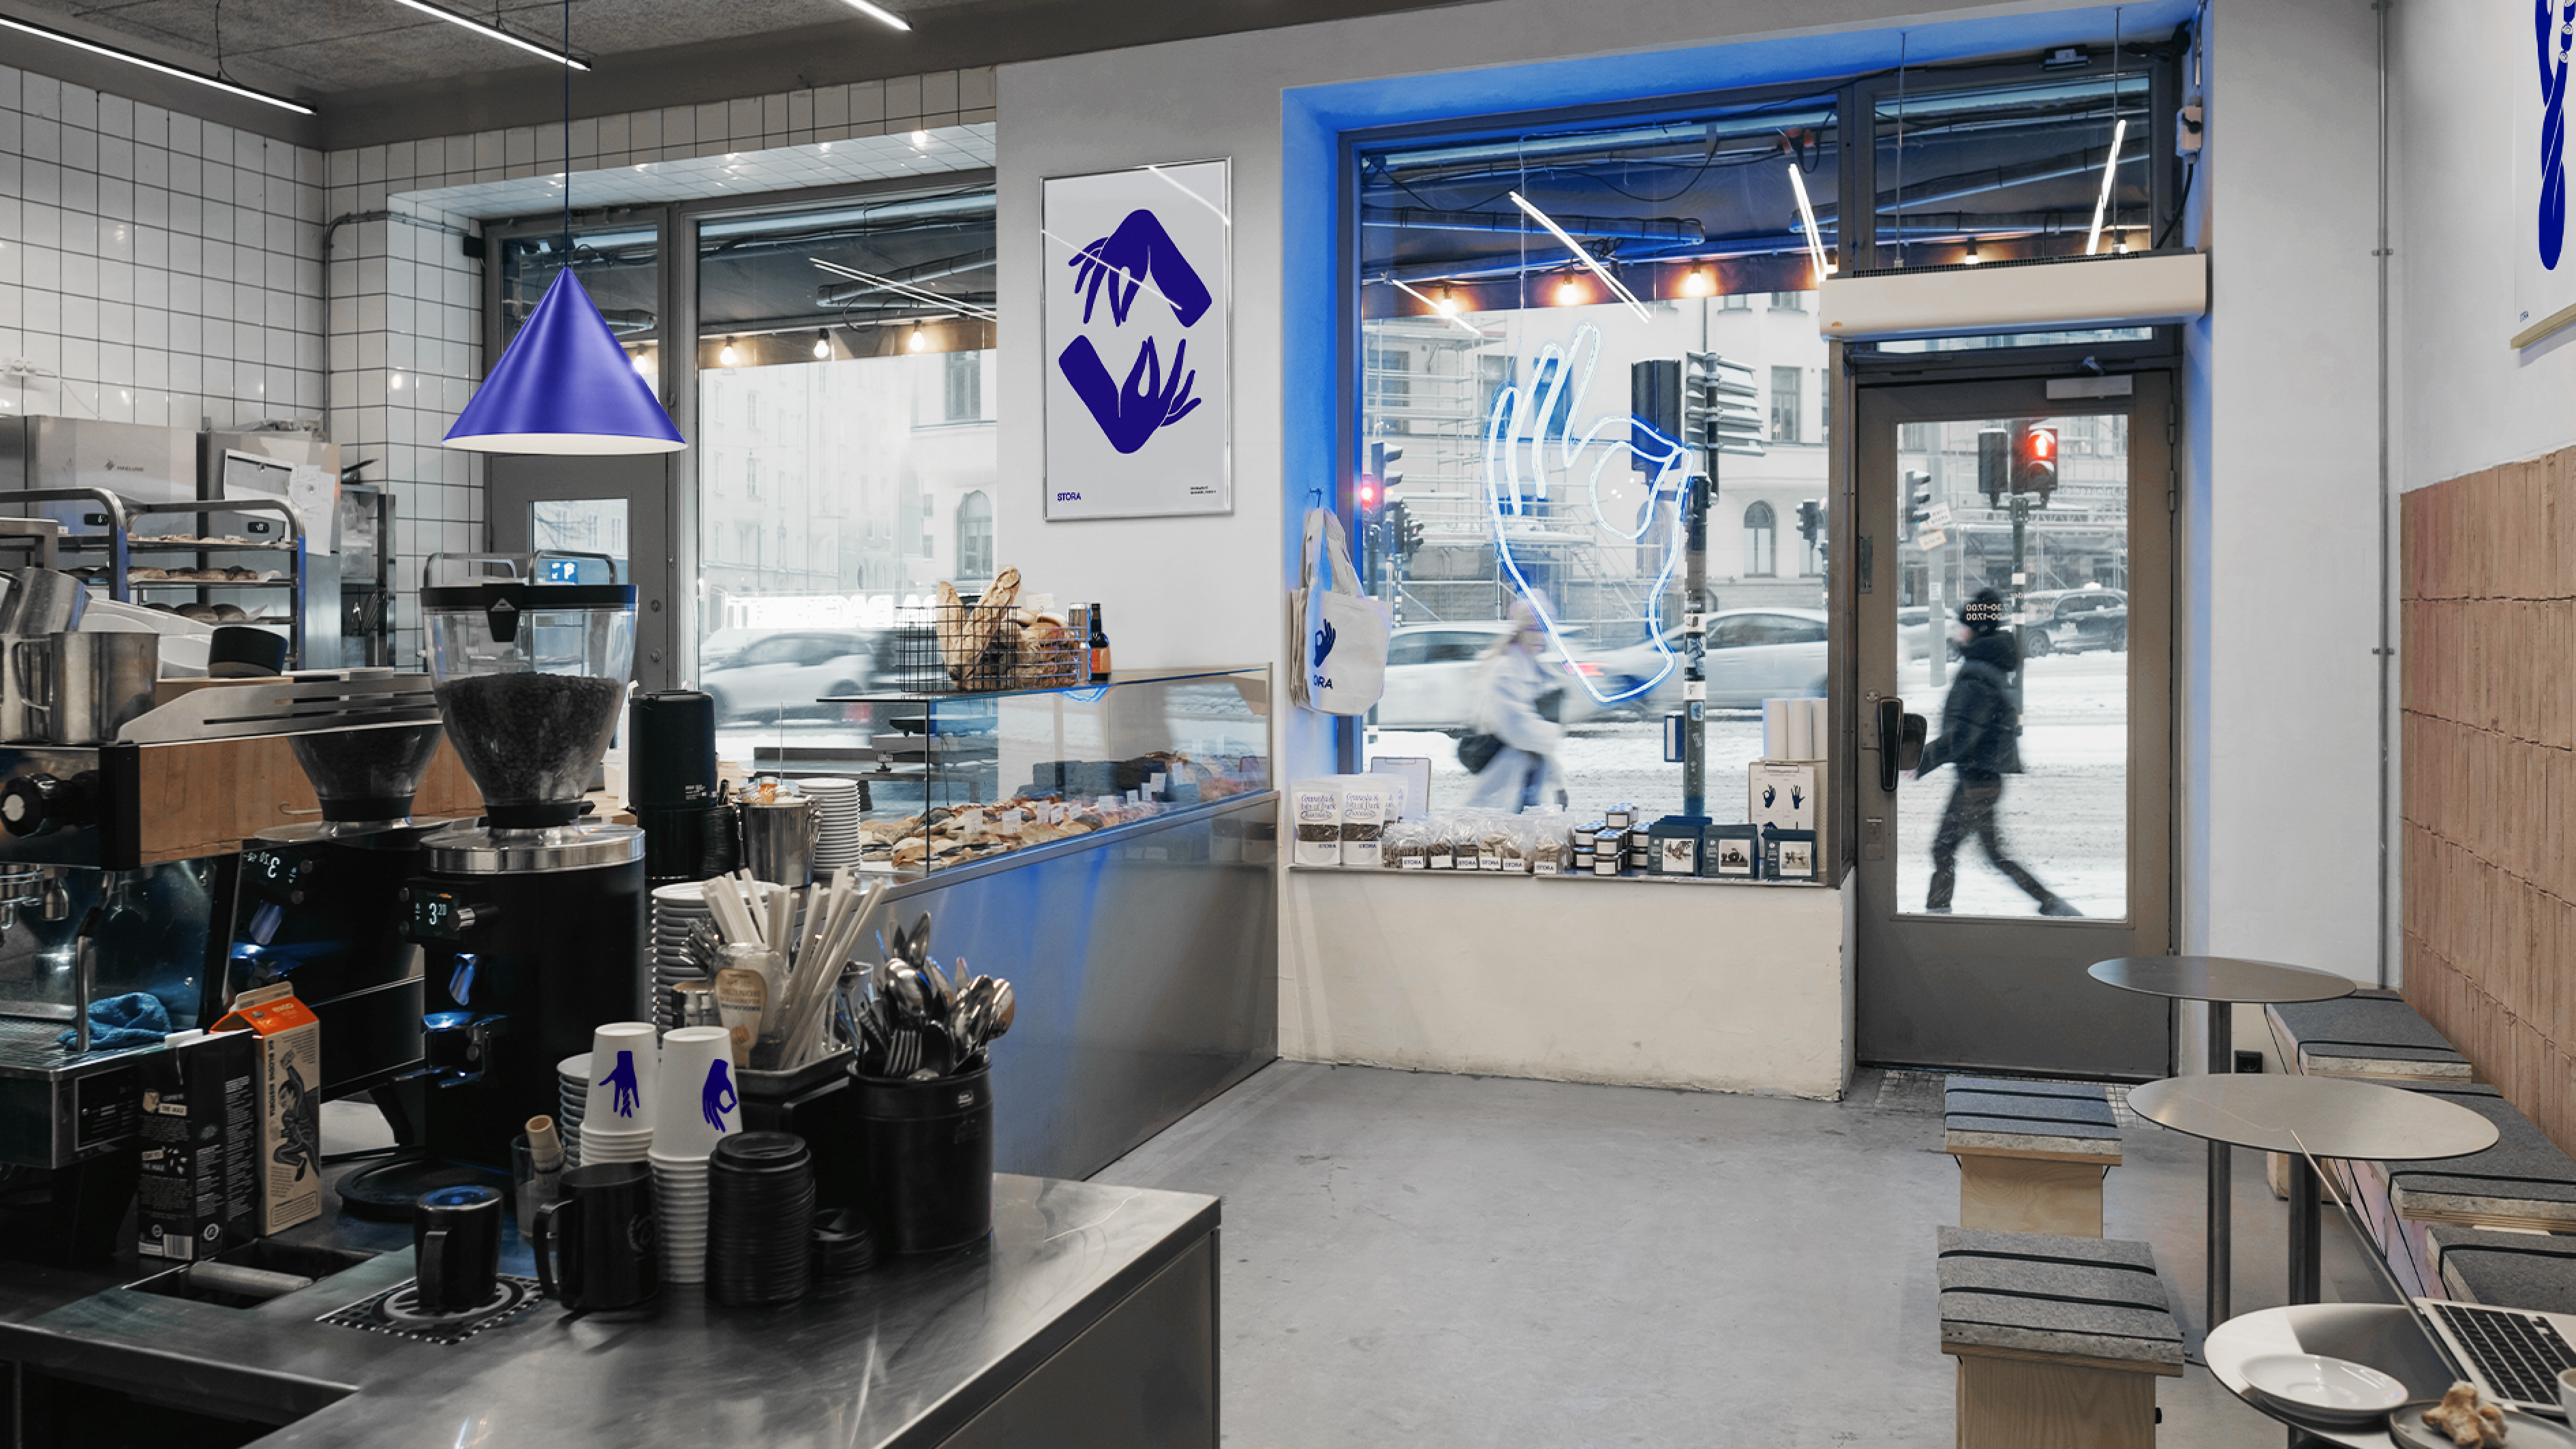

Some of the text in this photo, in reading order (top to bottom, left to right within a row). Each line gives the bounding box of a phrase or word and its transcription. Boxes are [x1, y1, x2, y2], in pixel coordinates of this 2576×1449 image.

[1057, 491, 1082, 502] STORA
[1301, 794, 1328, 802] Granola
[1346, 793, 1372, 802] Granola
